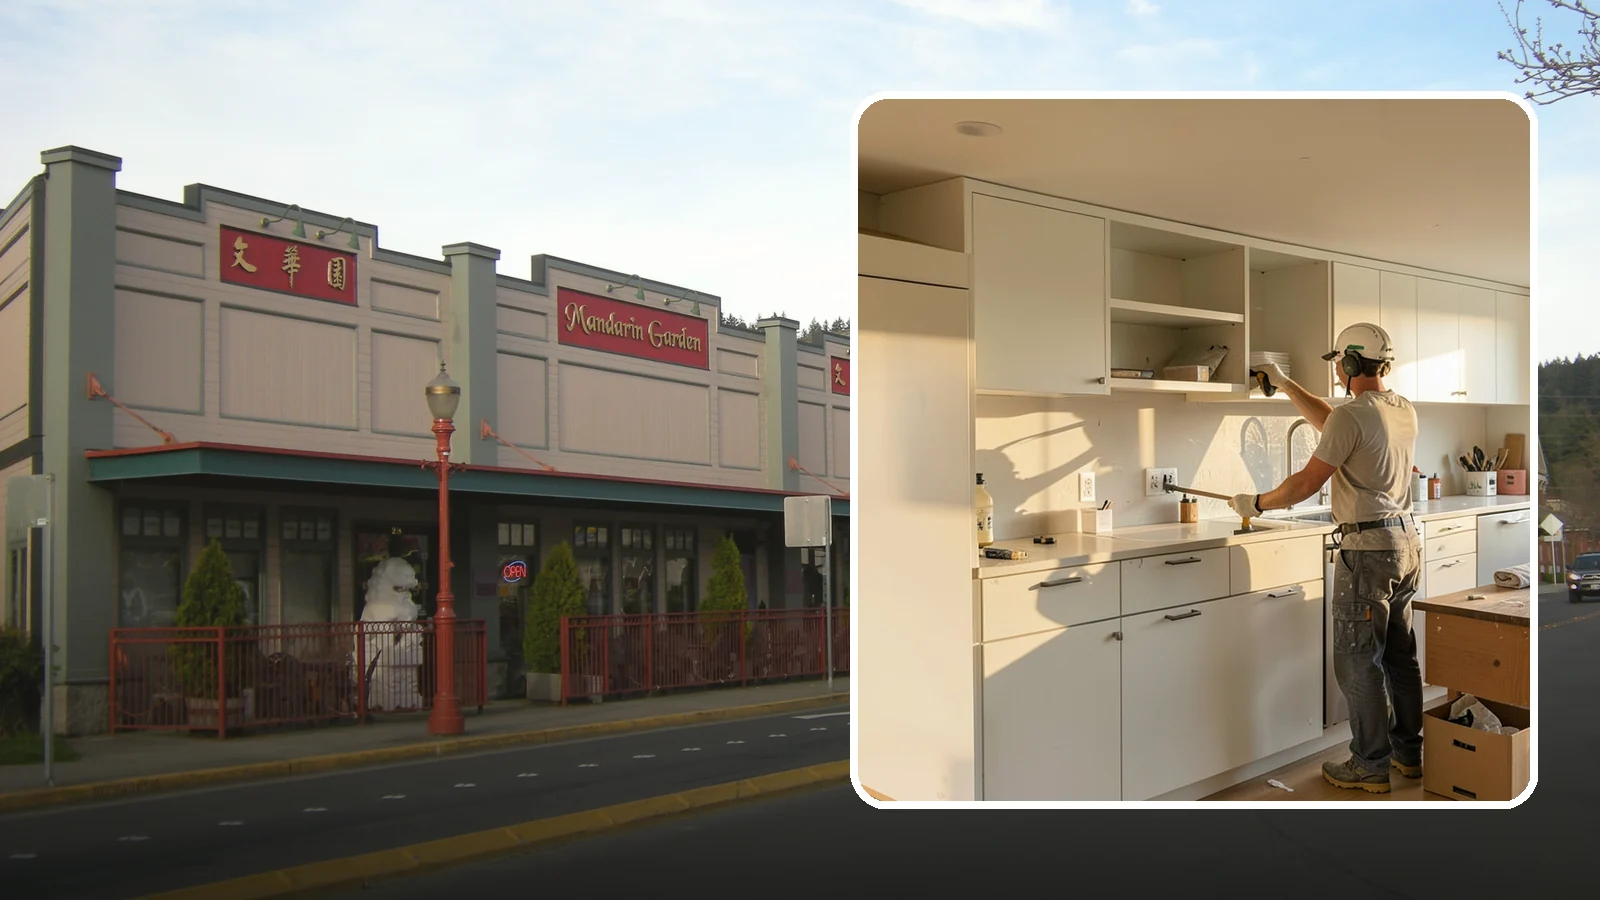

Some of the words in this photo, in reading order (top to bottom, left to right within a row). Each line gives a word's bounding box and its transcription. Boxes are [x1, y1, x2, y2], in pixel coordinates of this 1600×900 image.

[231, 235, 346, 291] 文華園
[564, 302, 644, 341] Mandarin
[647, 320, 701, 352] Garden
[503, 565, 527, 578] OPEN
